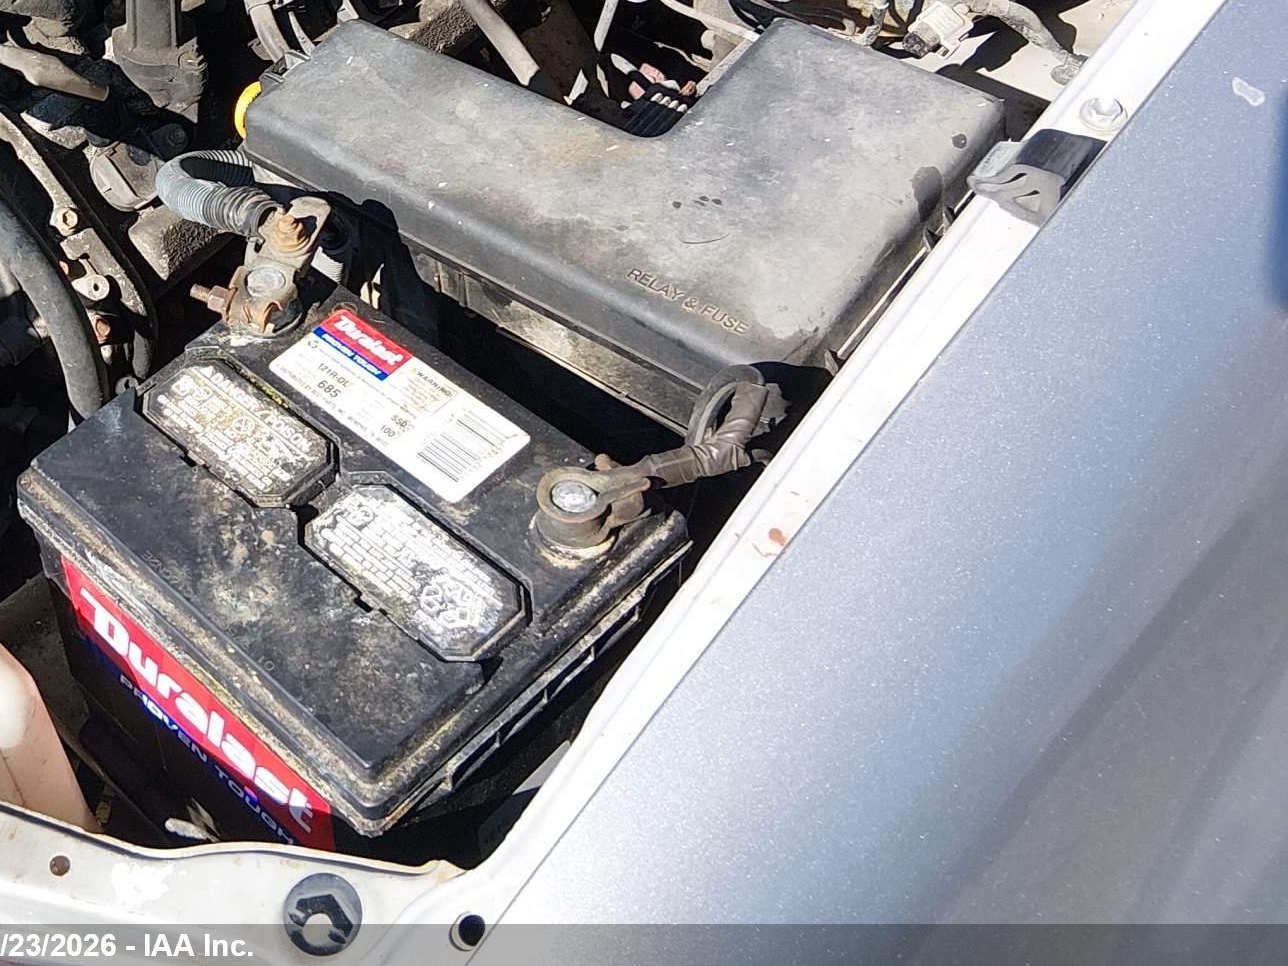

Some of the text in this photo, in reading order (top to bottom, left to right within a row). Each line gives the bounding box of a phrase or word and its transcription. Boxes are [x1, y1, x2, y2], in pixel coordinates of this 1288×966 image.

[626, 268, 749, 335] RELAY & FUSE
[333, 315, 404, 366] Duralast
[213, 373, 260, 413] DANGER
[265, 413, 314, 452] POISON
[317, 380, 396, 439] 685 100
[80, 587, 314, 835] Duralast
[119, 673, 295, 845] PROVEN TOUGH
